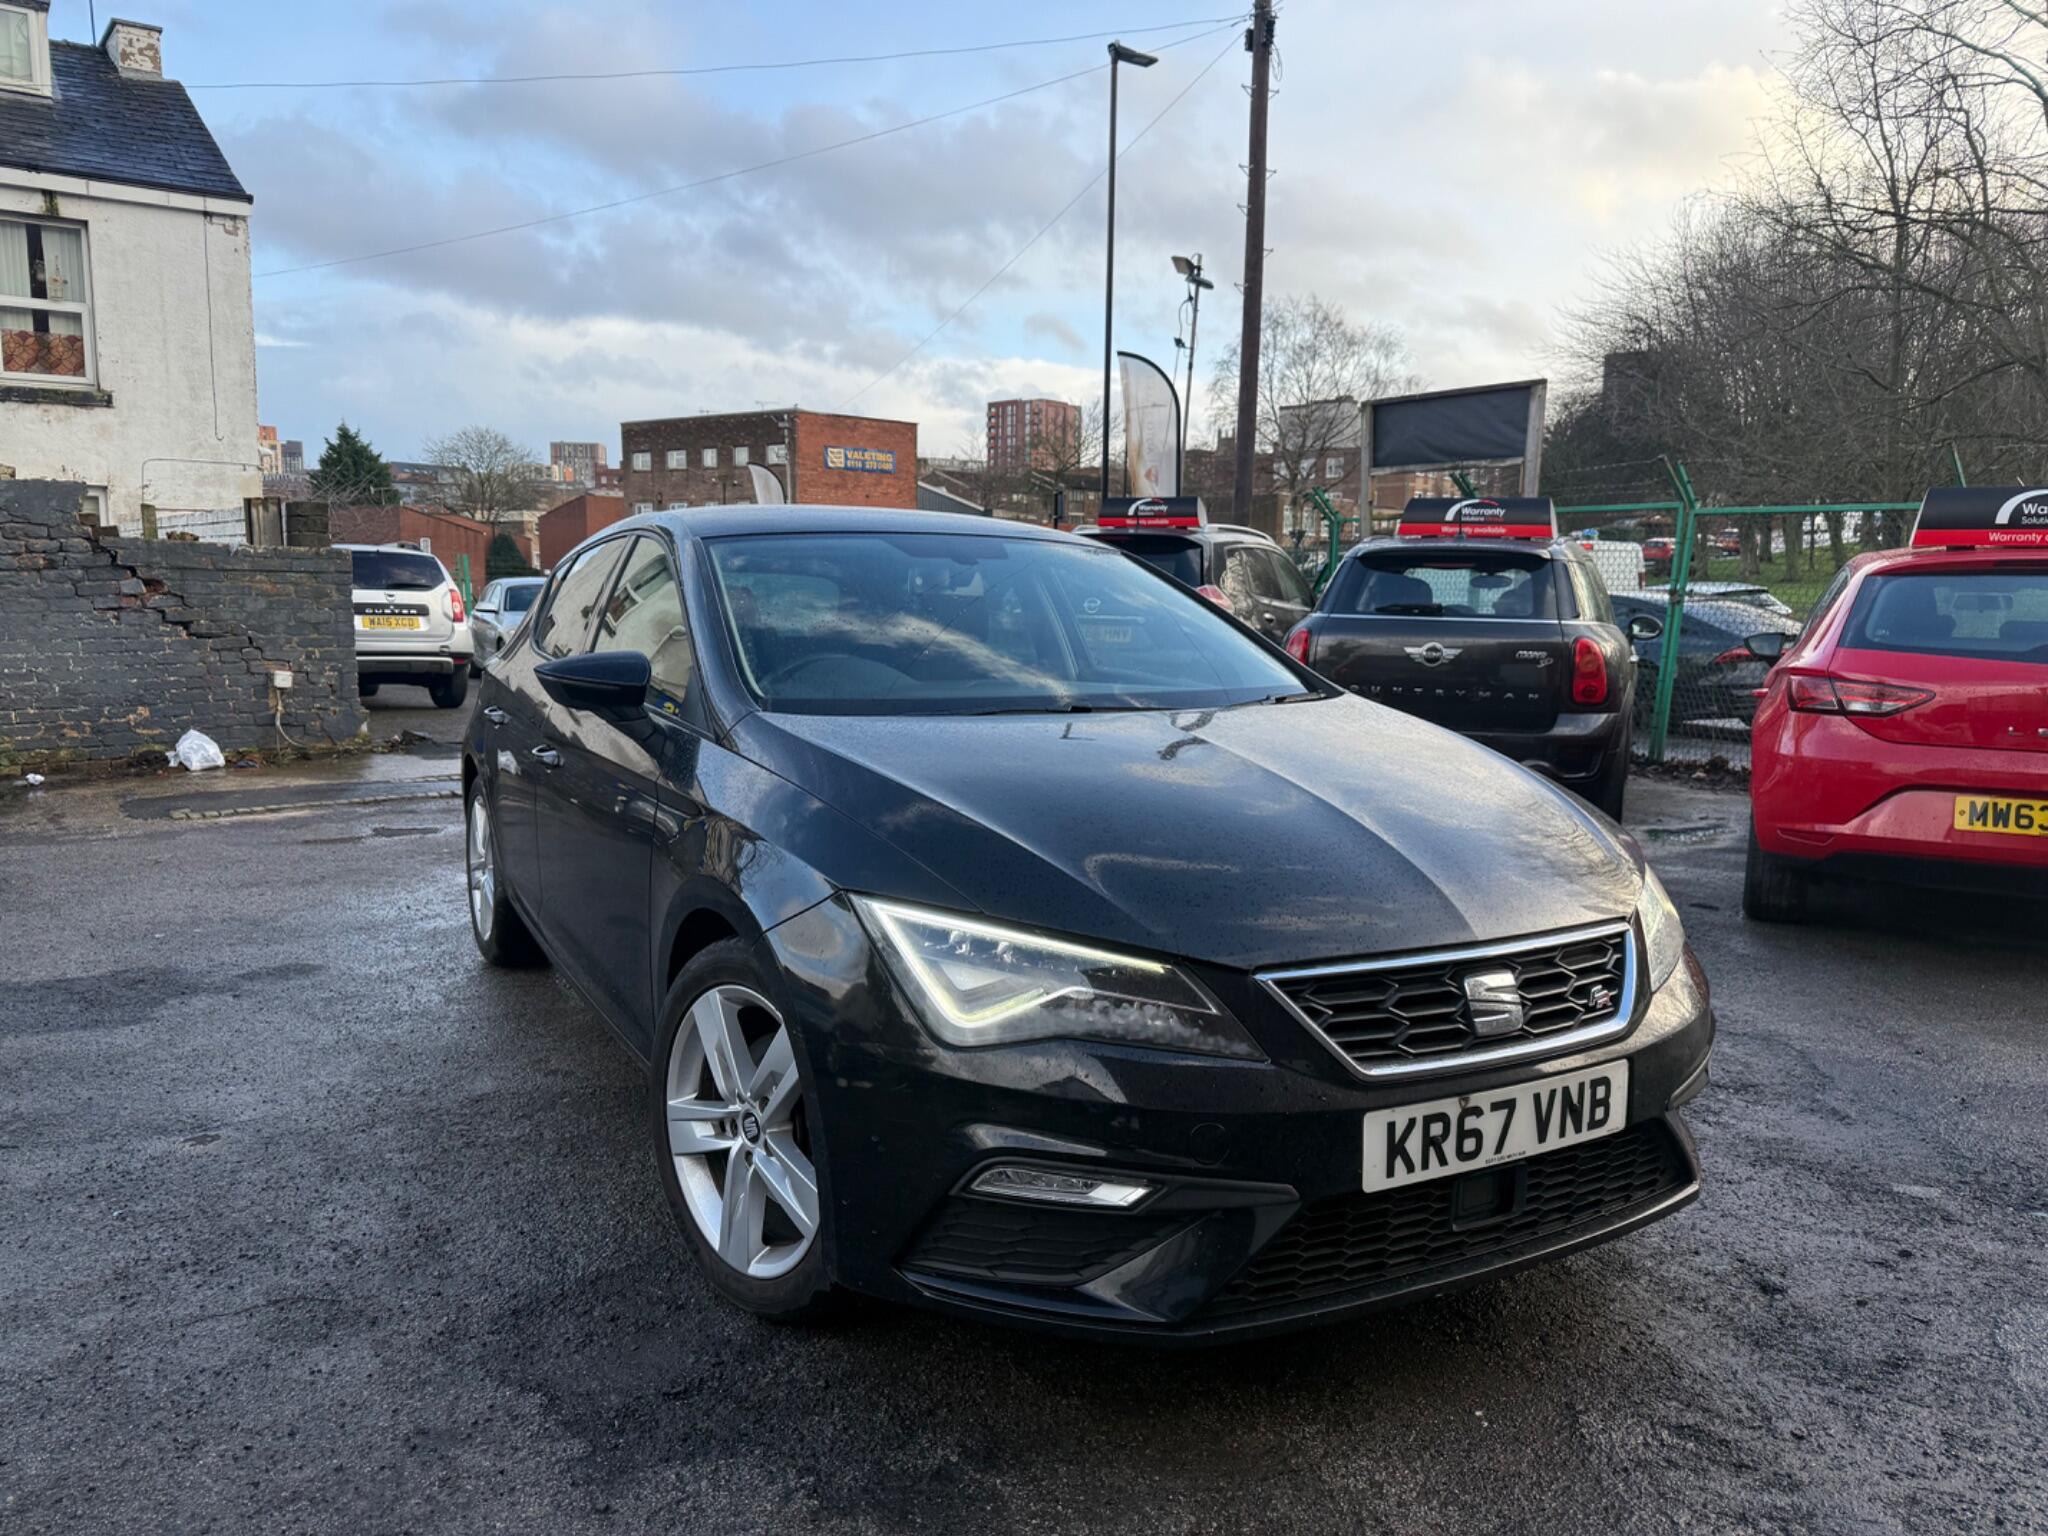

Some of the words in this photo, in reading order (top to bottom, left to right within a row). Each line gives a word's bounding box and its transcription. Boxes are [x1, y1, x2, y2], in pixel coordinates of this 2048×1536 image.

[846, 450, 893, 462] VALETING
[1461, 507, 1506, 517] Warranty
[1989, 531, 2043, 543] Warranty
[1350, 684, 1539, 699] OUNTRYMAN
[1385, 1097, 1517, 1180] KR67
[1532, 1076, 1612, 1145] VNB
